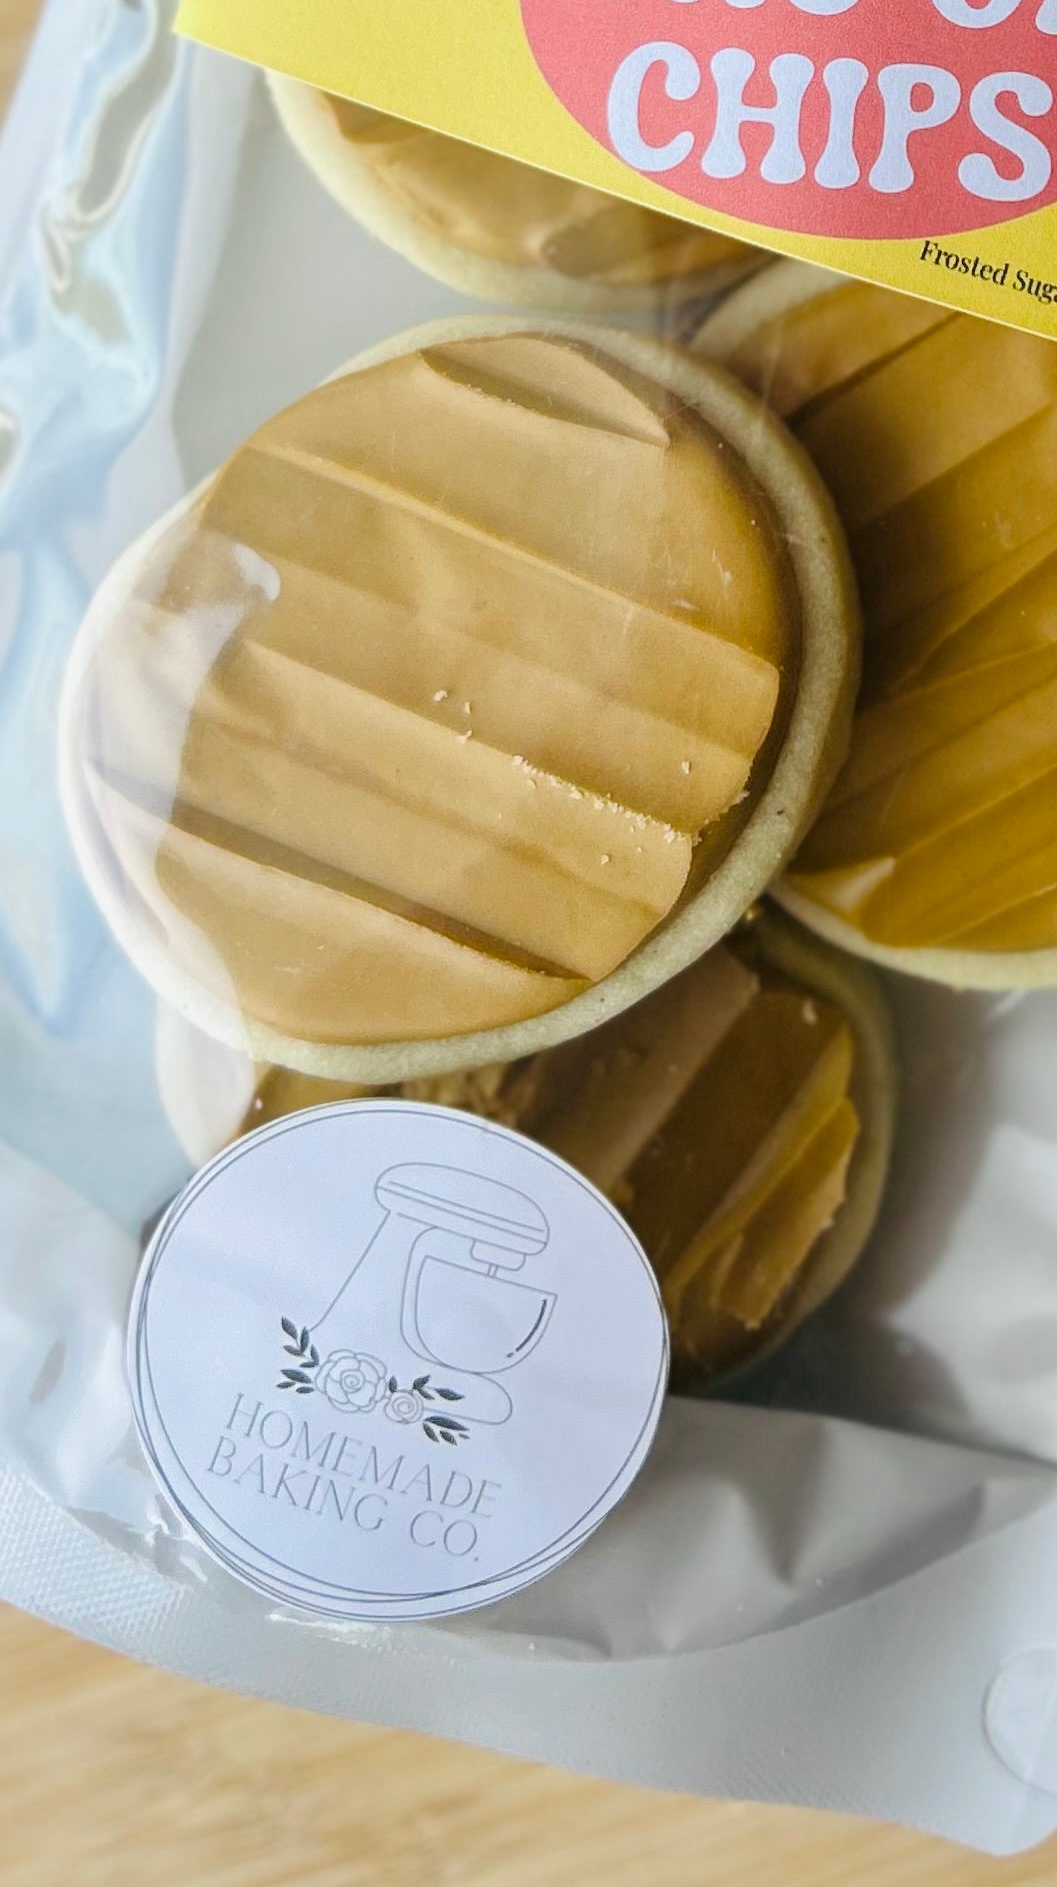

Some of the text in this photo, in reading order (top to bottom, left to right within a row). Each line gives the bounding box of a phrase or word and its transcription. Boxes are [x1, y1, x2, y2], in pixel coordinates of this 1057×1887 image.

[607, 40, 1053, 202] CHIPS
[919, 240, 1010, 286] Frosted
[207, 1435, 479, 1562] BAKING CO.
[226, 1393, 502, 1518] HOMEMADE
